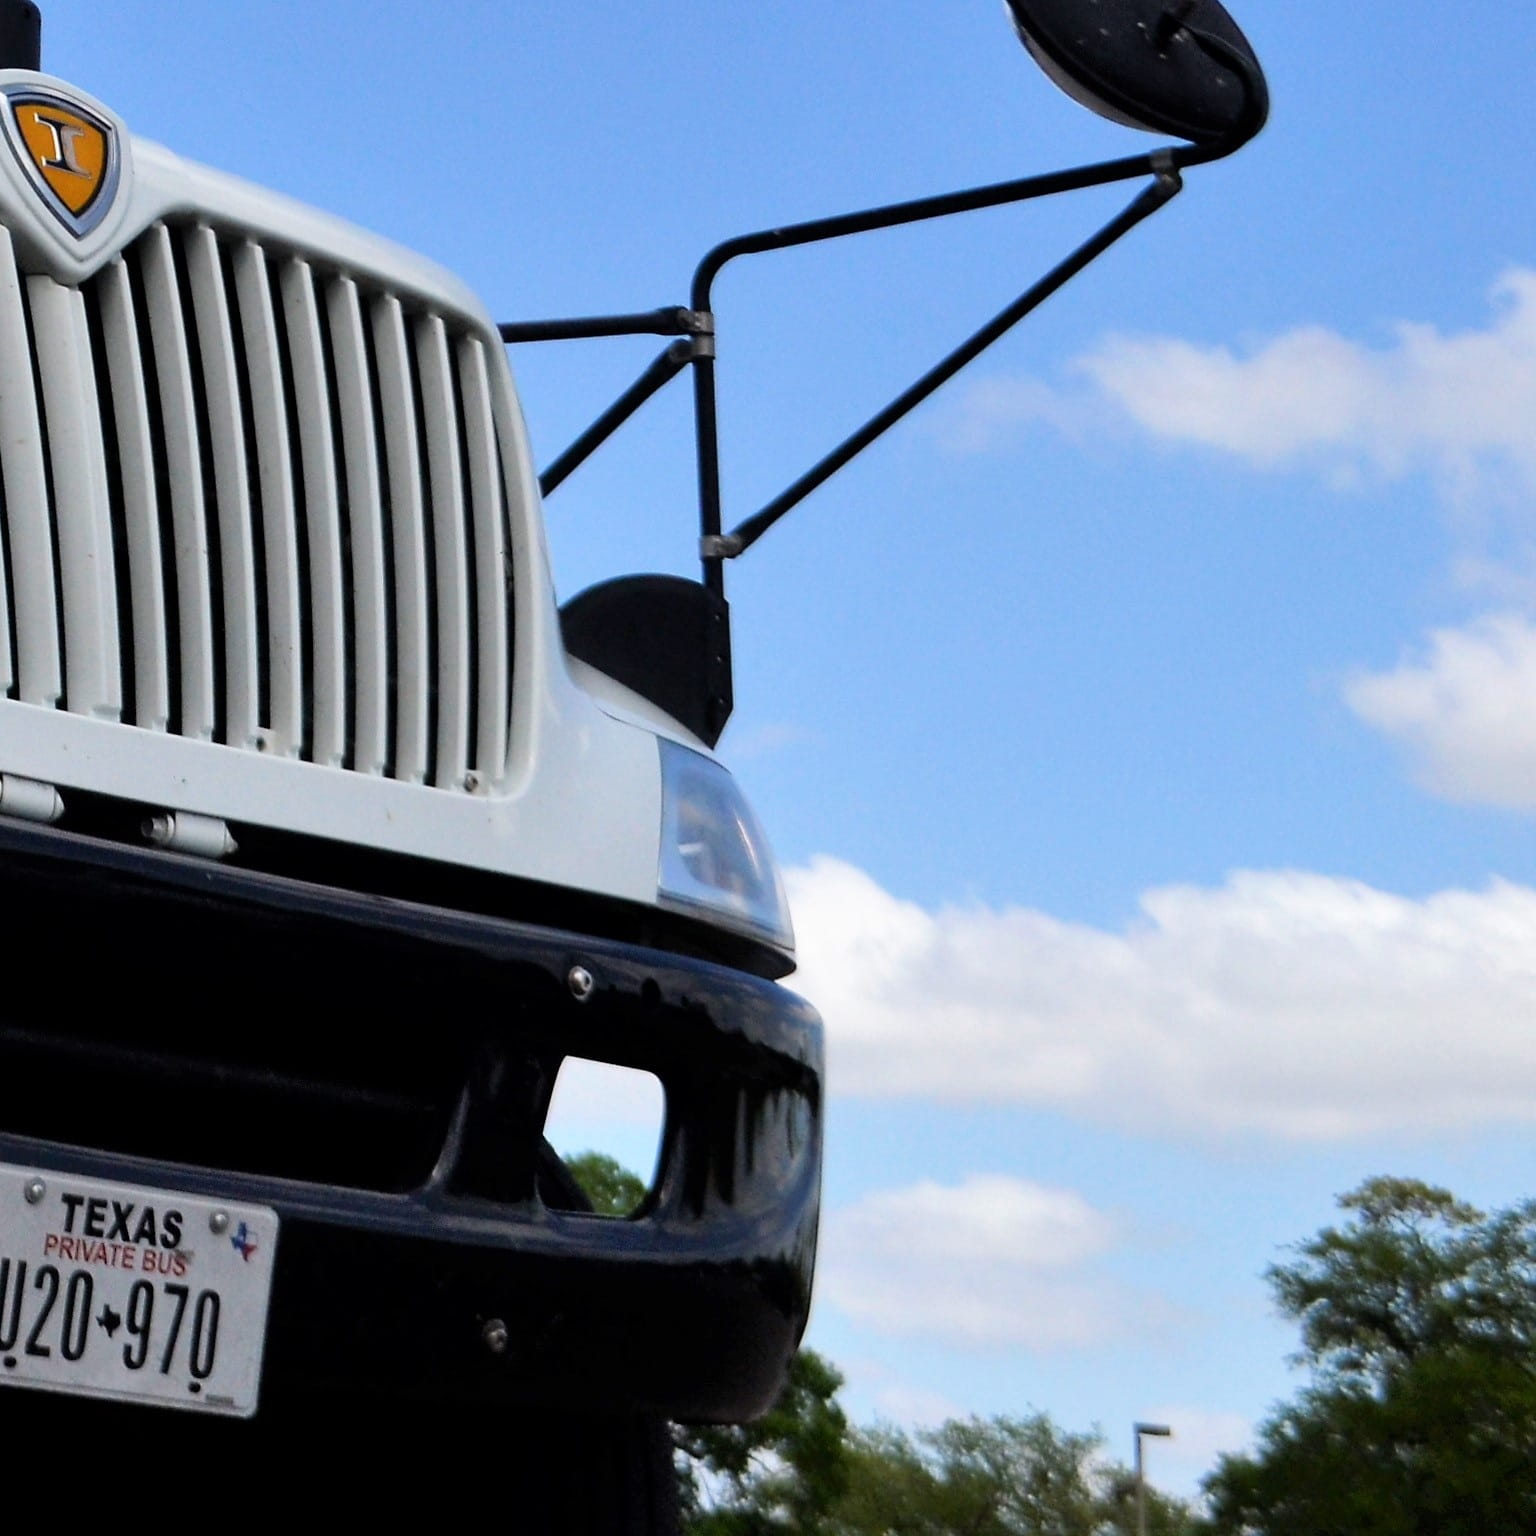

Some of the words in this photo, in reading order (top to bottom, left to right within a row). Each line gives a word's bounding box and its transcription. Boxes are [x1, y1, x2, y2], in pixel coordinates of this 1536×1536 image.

[61, 1192, 184, 1249] TEXAS
[43, 1233, 135, 1270] PRIVATE
[141, 1248, 188, 1277] BUS
